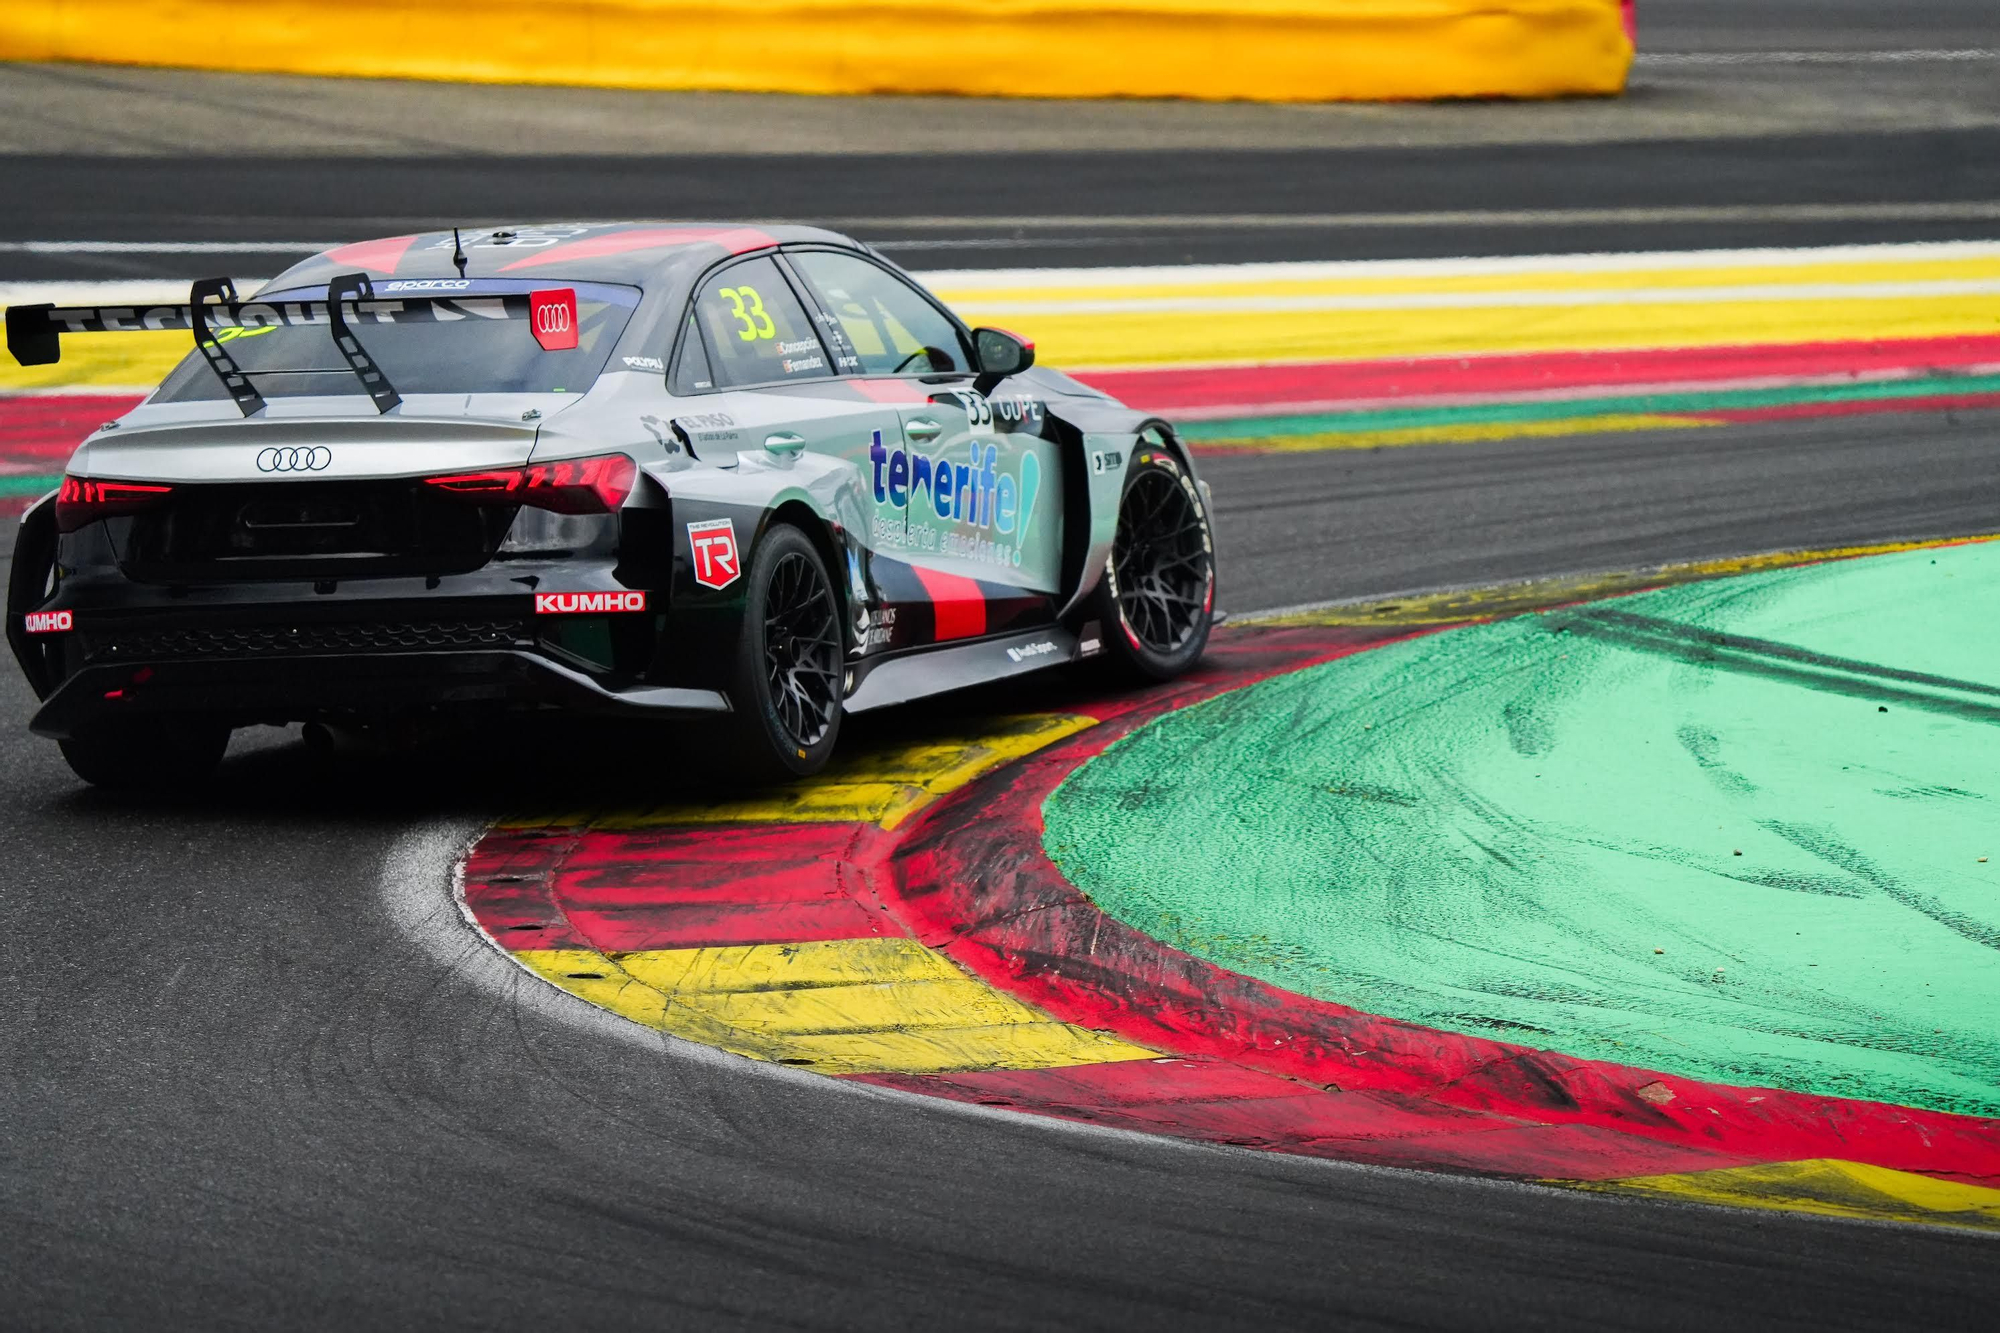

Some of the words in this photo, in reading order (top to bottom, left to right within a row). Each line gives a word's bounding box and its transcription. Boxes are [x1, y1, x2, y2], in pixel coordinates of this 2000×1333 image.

[719, 285, 776, 341] 33
[957, 390, 992, 425] 33
[868, 427, 1042, 568] tenerife!
[701, 520, 731, 529] REVOLUTION
[695, 536, 735, 578] TR
[536, 592, 645, 613] KUMHO
[25, 611, 72, 632] KUMHO
